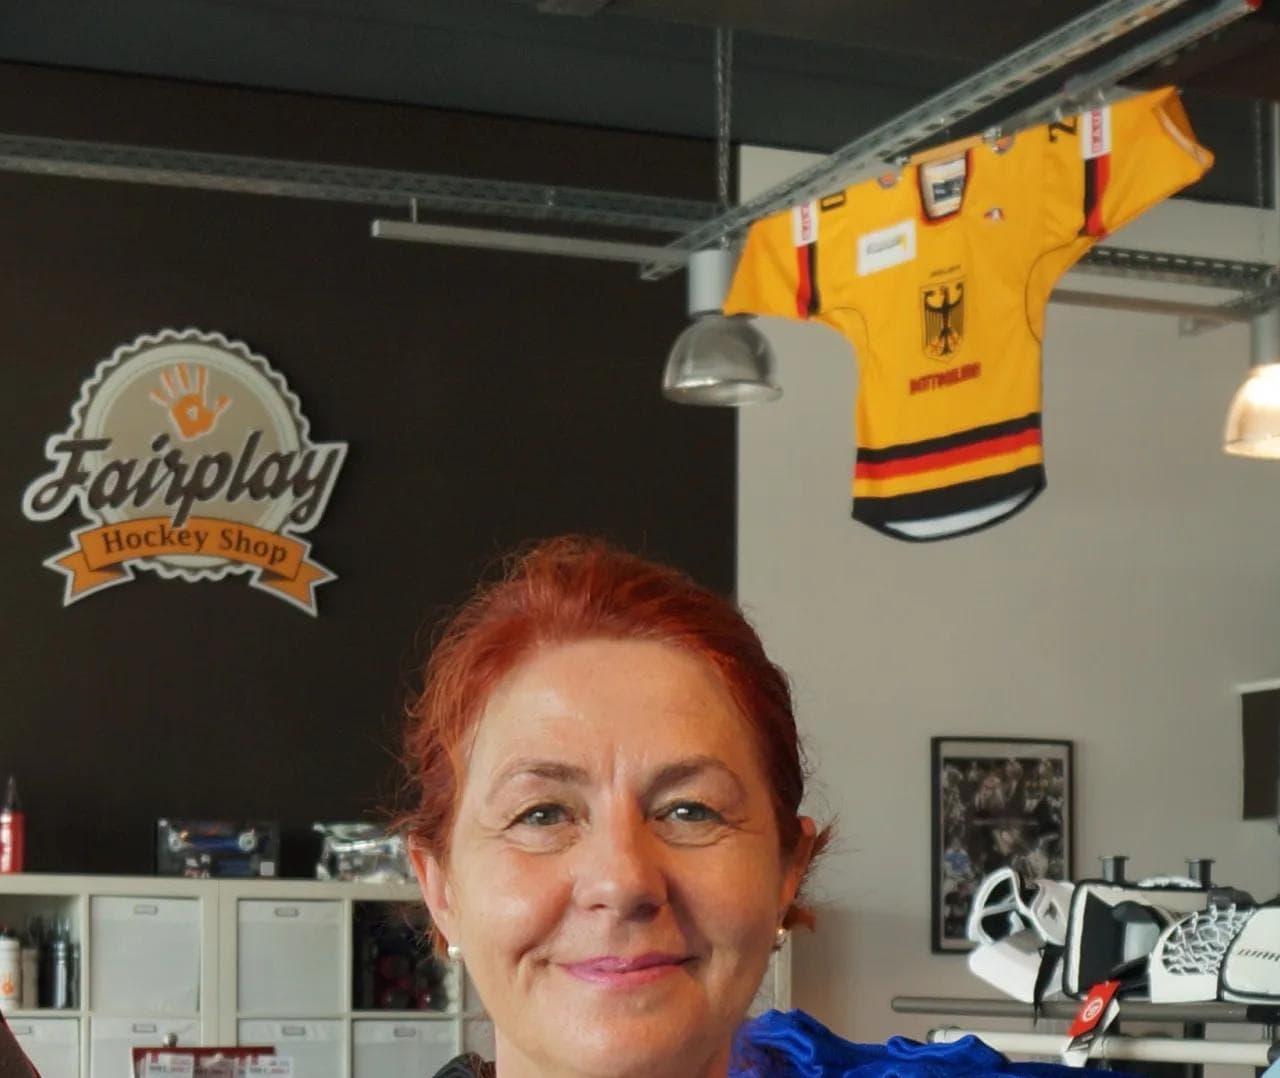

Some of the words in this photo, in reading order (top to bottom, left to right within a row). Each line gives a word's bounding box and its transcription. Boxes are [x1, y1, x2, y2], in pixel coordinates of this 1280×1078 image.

[30, 429, 342, 529] Fairplay
[101, 524, 209, 555] Hockey
[219, 527, 289, 565] Shop
